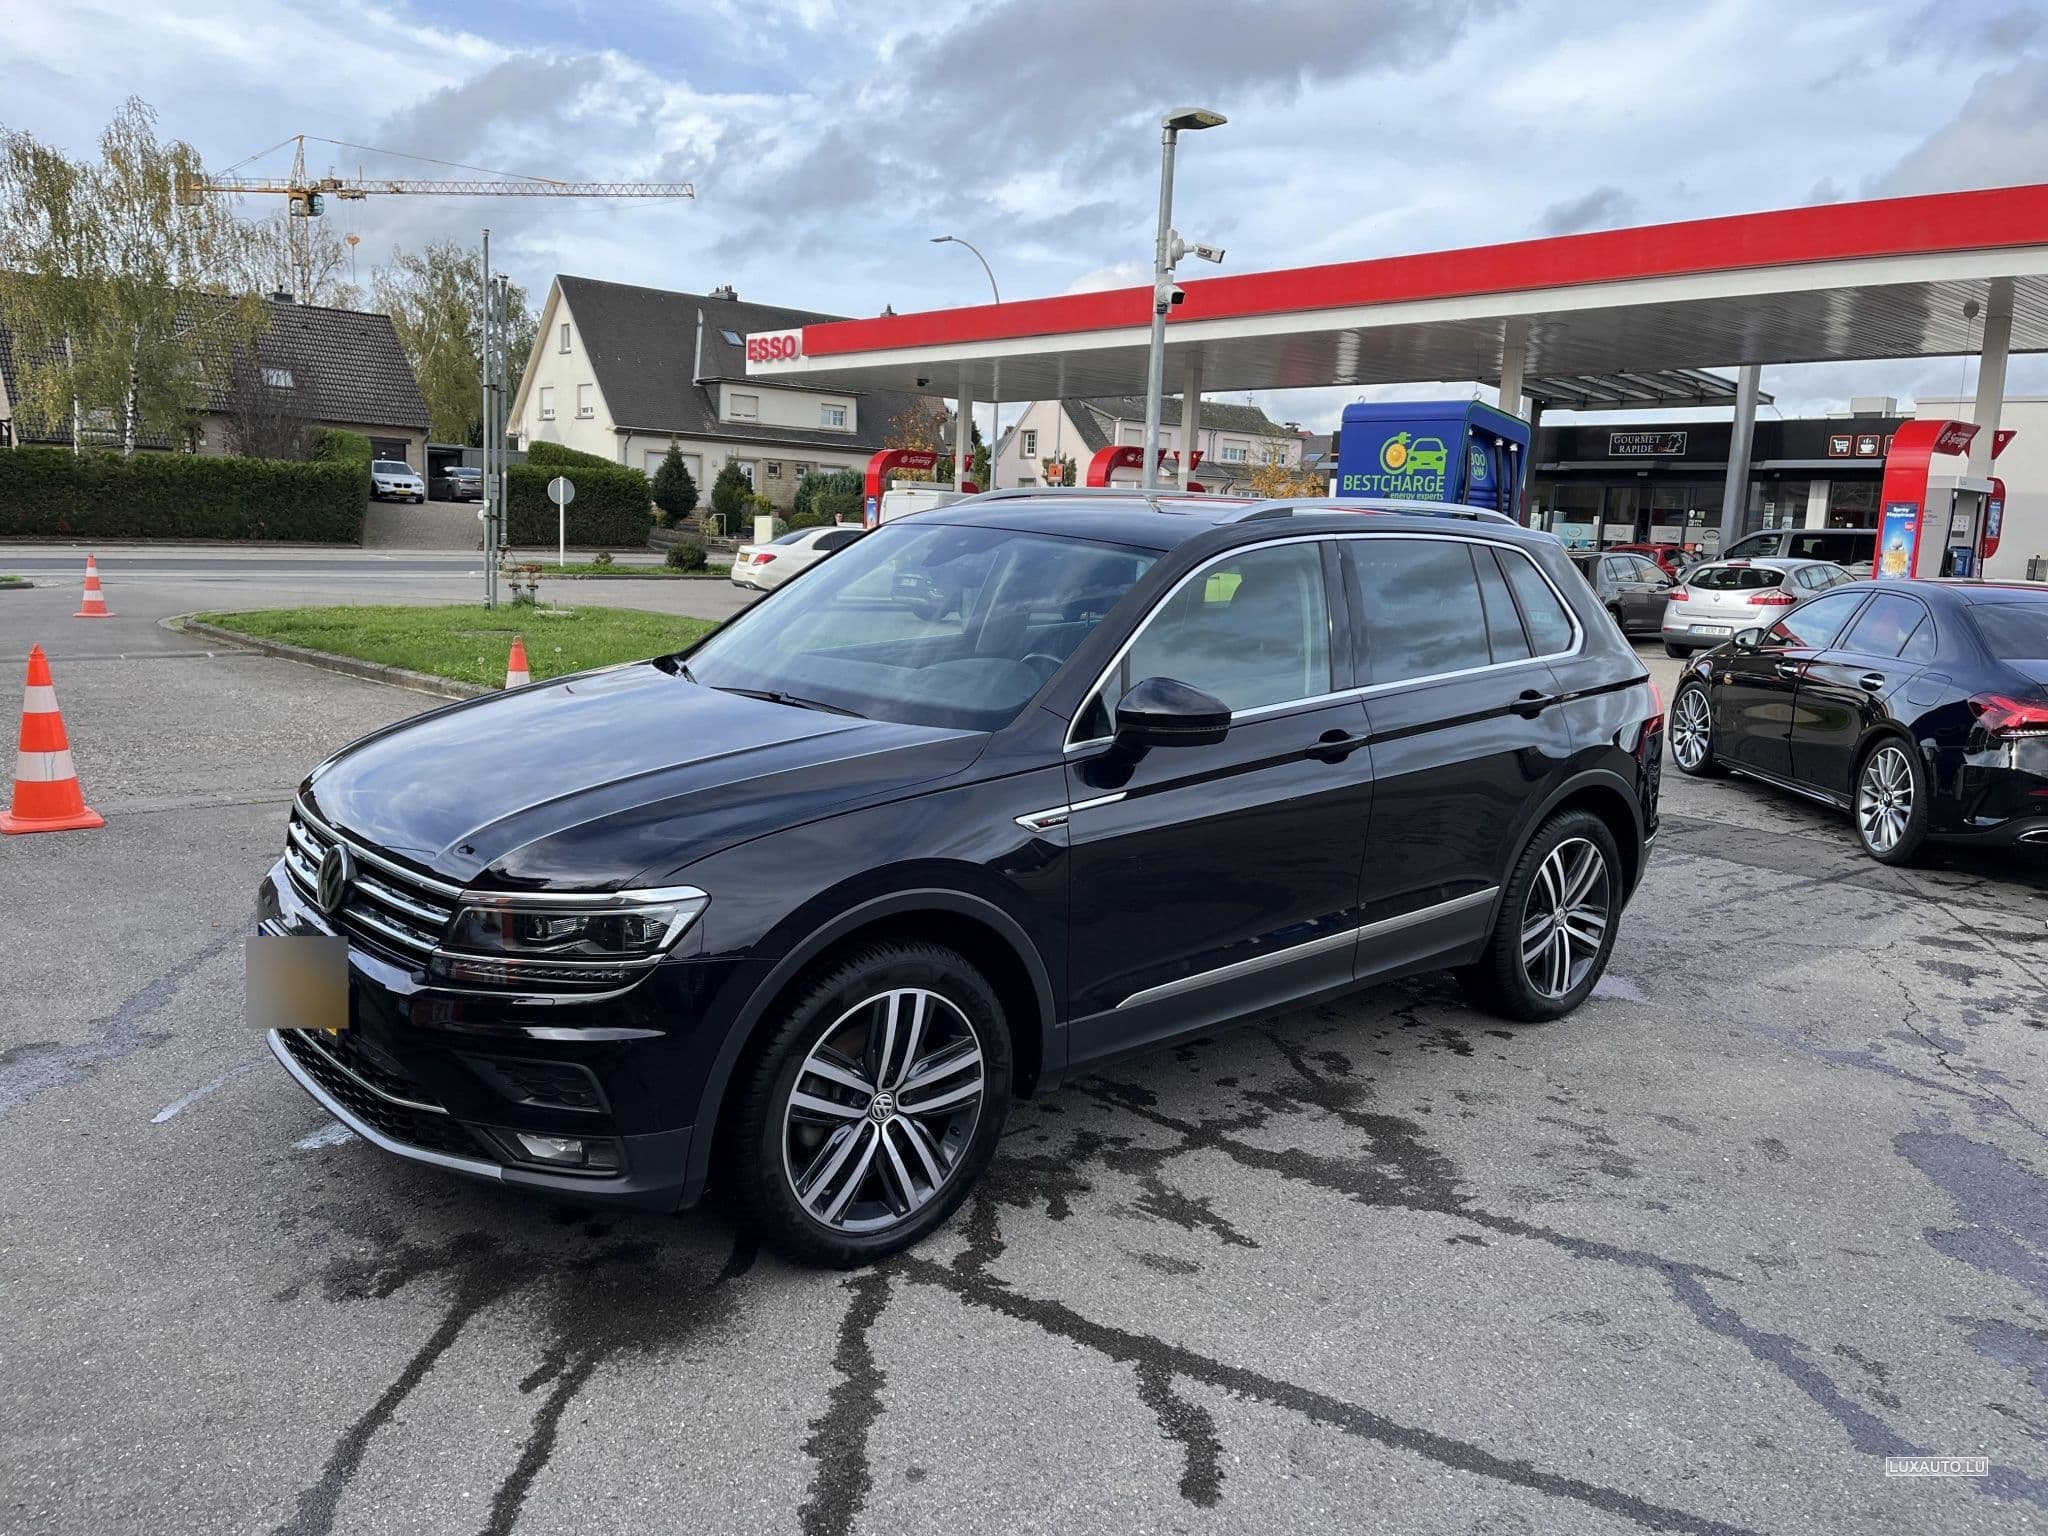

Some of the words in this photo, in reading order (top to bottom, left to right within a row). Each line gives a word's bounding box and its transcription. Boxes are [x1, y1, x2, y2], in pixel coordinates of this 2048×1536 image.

[747, 335, 796, 361] ESSO
[1614, 435, 1661, 444] GOURMET
[1619, 444, 1654, 453] RAPIDE
[908, 456, 932, 466] Synergy
[1343, 474, 1446, 492] BESTCHARGE
[1391, 492, 1415, 500] energy
[1416, 492, 1444, 501] experts
